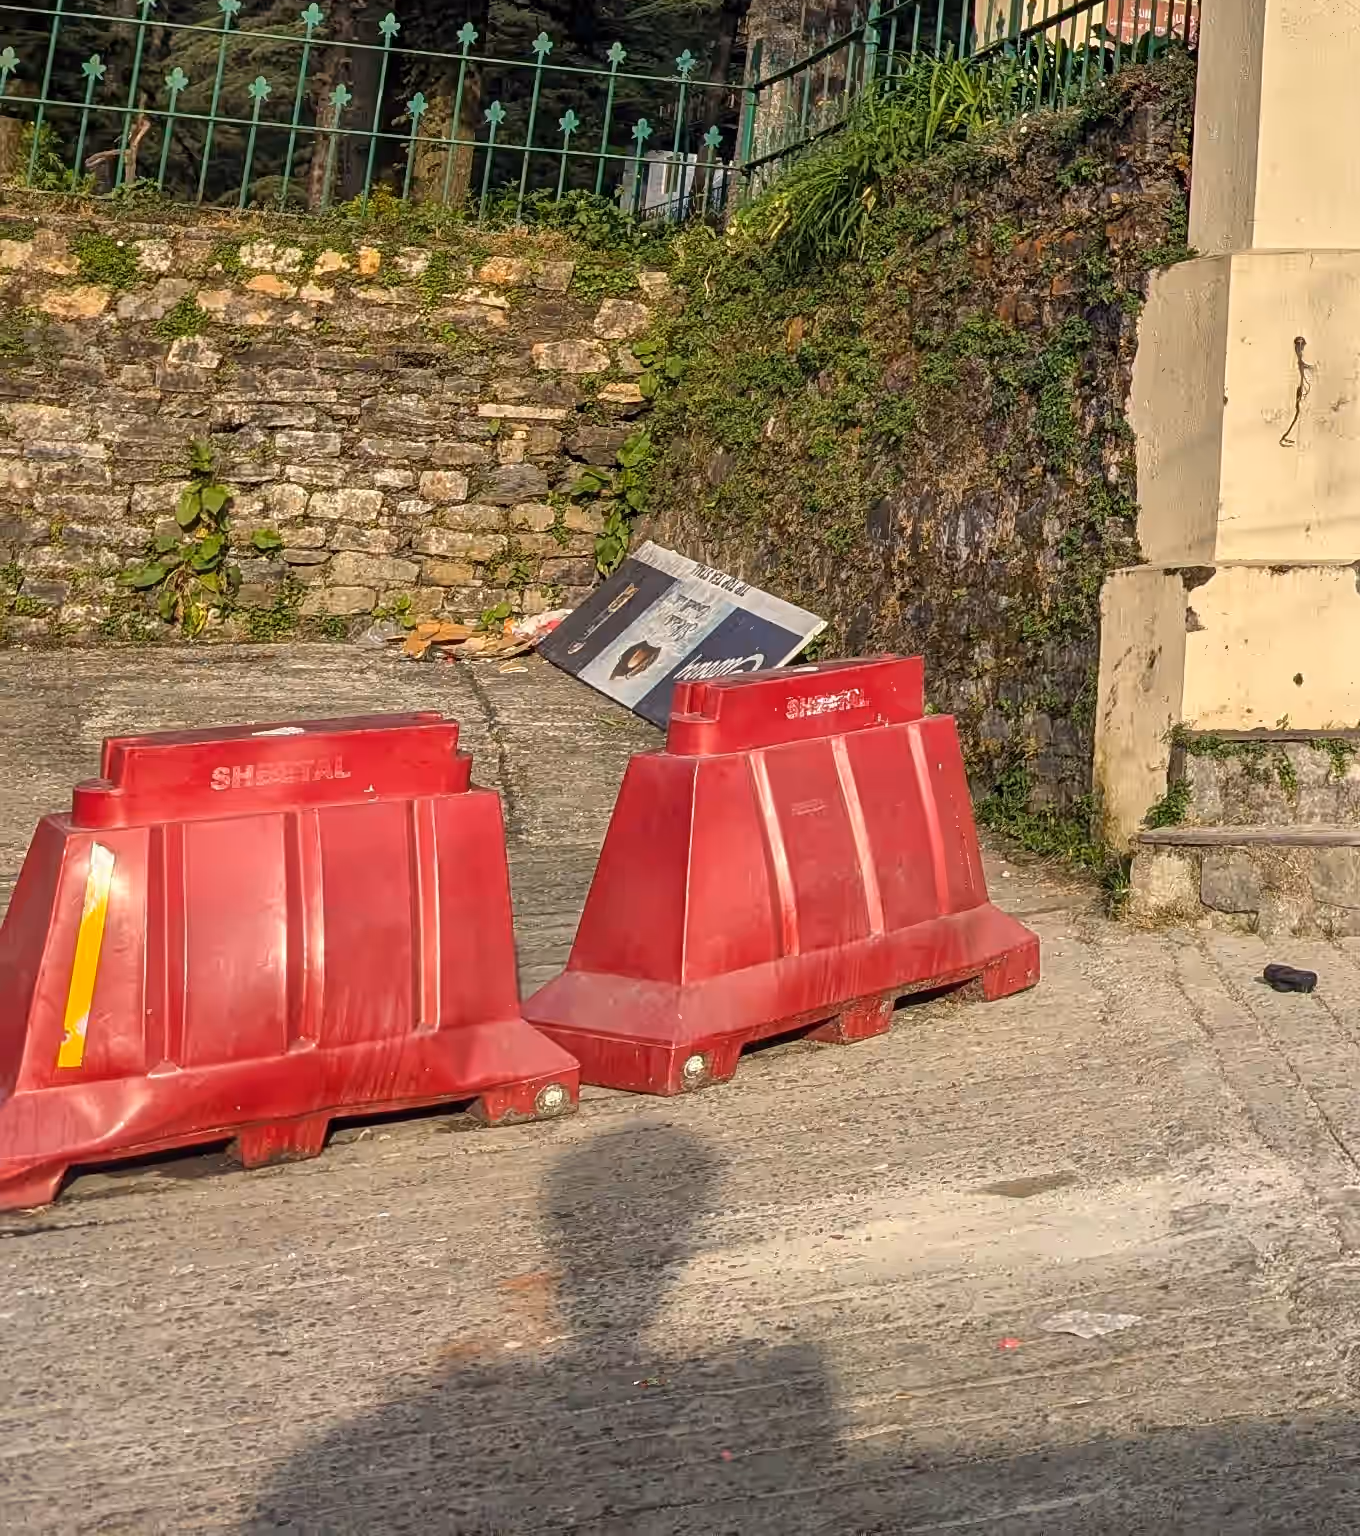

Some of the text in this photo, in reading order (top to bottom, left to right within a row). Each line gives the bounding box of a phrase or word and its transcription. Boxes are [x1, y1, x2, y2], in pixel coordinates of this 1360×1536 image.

[708, 572, 726, 586] TEA
[721, 577, 739, 592] TOP
[734, 583, 752, 597] TIP
